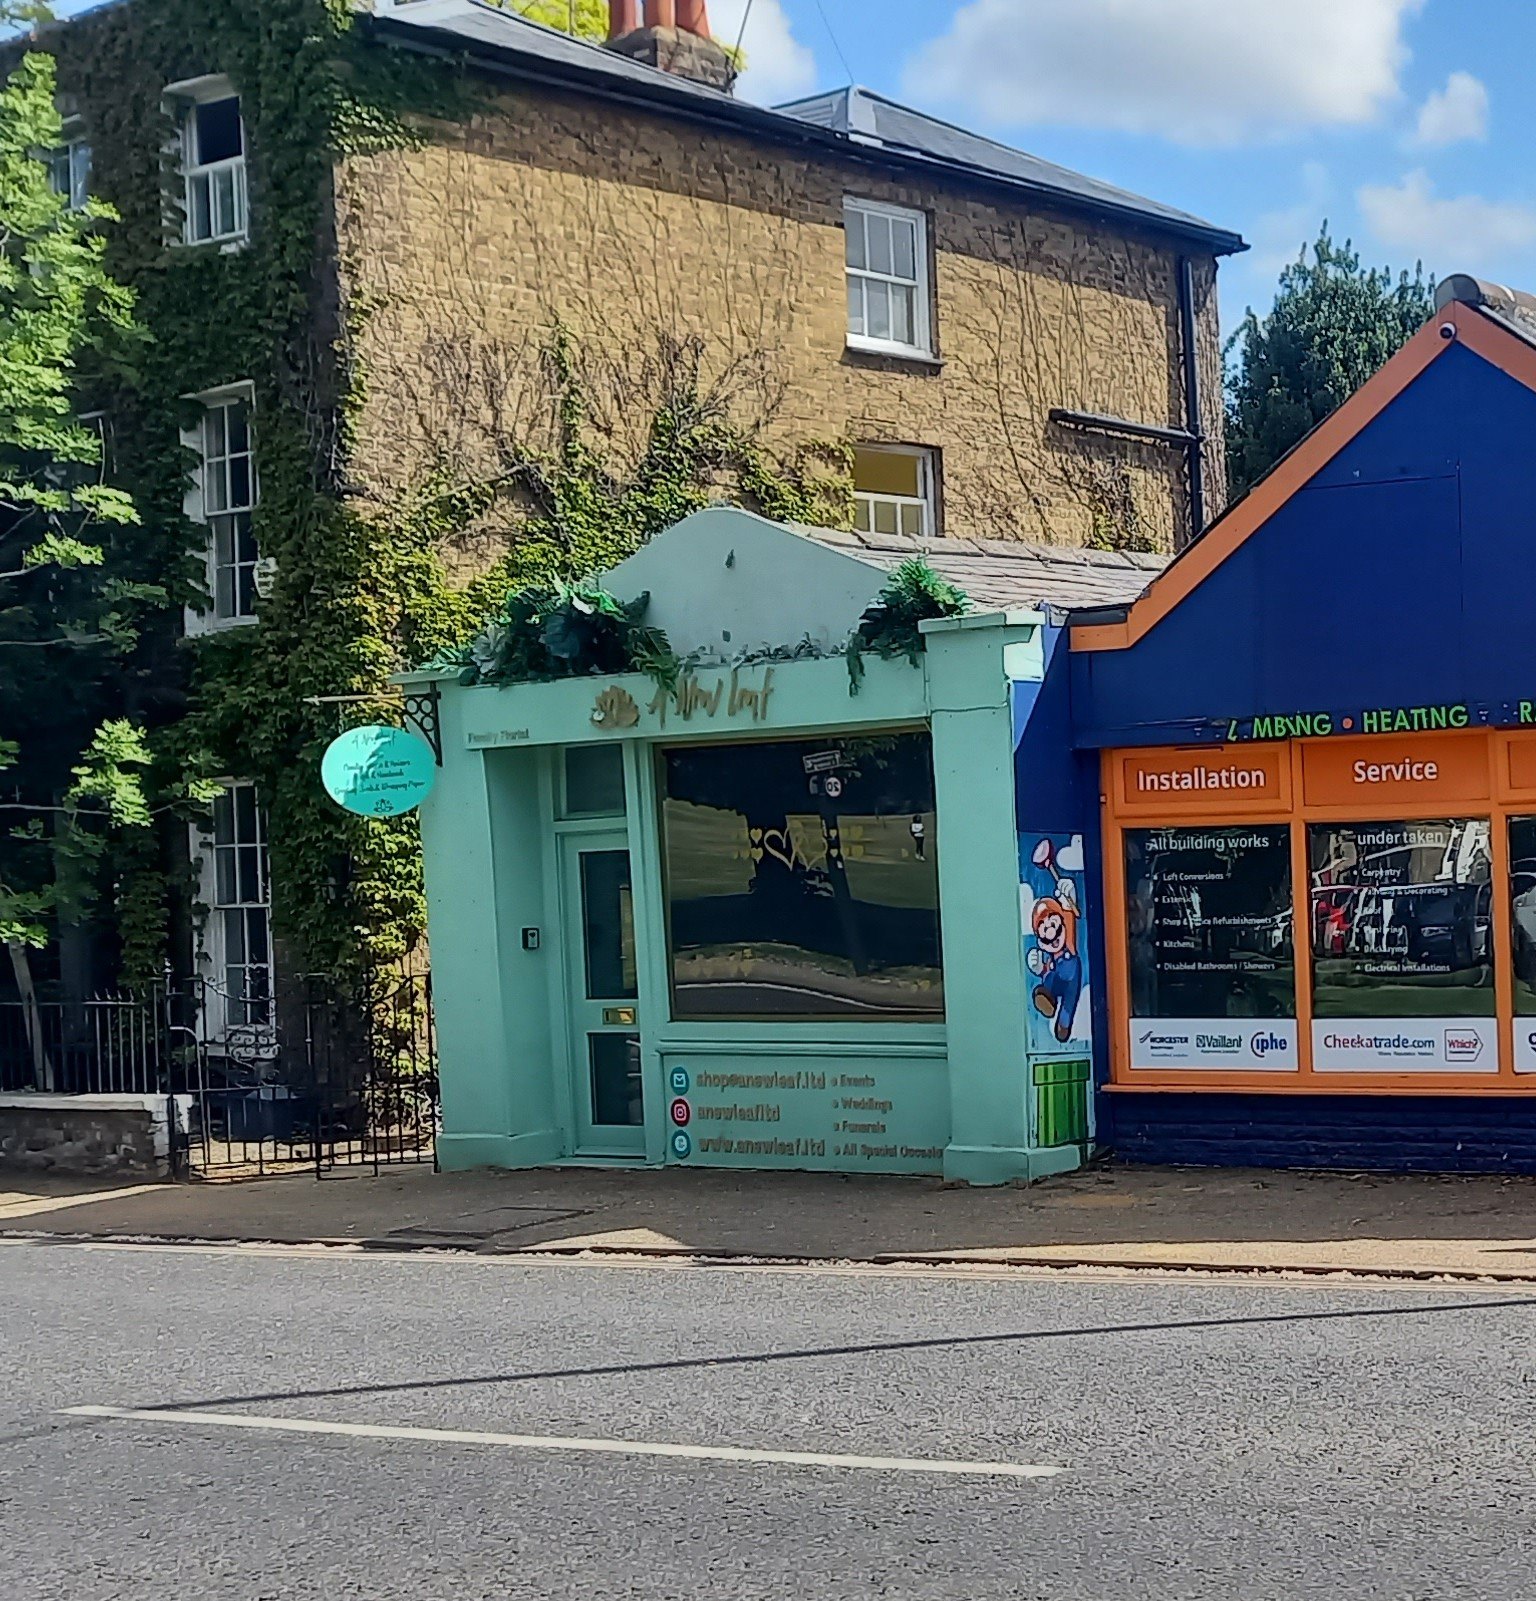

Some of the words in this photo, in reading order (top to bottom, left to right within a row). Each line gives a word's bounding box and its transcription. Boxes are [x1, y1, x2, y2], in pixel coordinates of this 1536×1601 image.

[1363, 706, 1468, 732] HEATING
[1138, 766, 1265, 791] Installation
[1354, 758, 1438, 783] Service
[1169, 836, 1225, 852] building
[1227, 834, 1270, 848] works
[1357, 831, 1399, 845] under
[1402, 829, 1443, 844] taken
[1206, 1034, 1243, 1048] Vaillant
[1447, 1038, 1478, 1049] Which?
